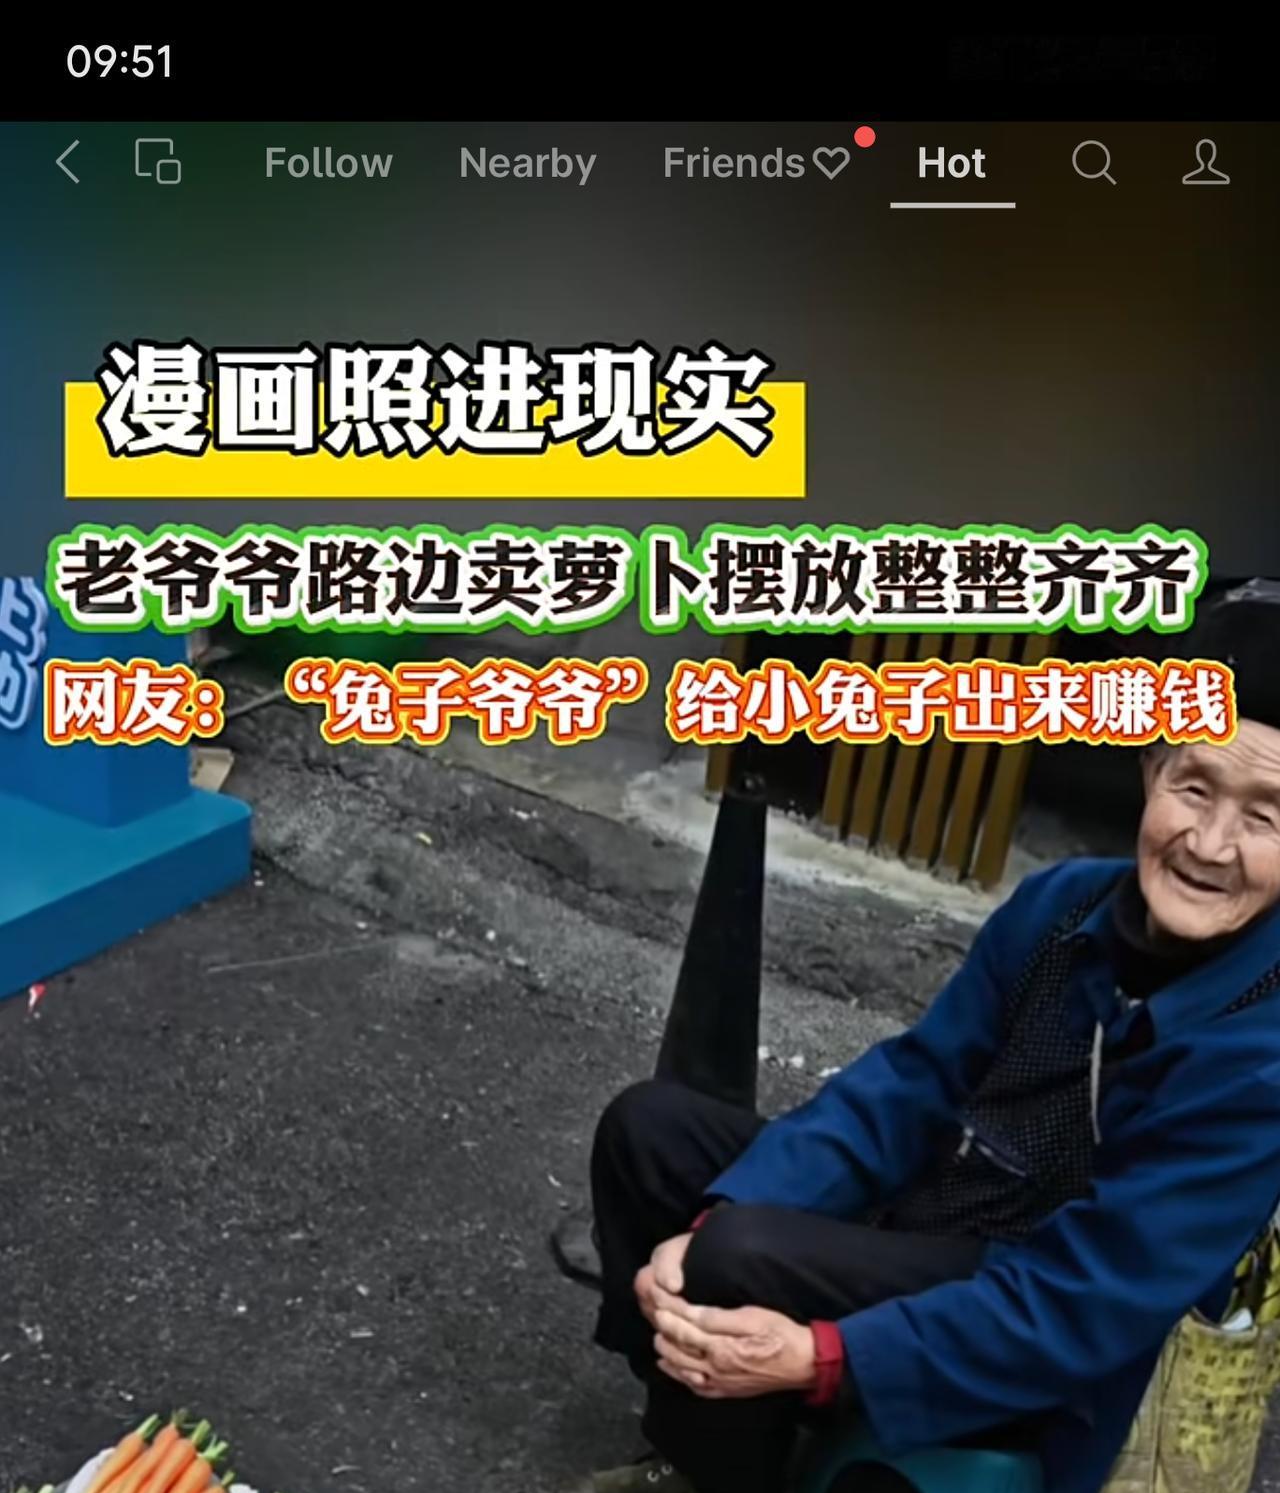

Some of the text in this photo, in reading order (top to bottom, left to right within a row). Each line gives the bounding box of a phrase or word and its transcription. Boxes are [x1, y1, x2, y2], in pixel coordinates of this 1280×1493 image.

[66, 44, 172, 78] 09:51
[266, 146, 986, 186] Follow Nearby Friends Hot
